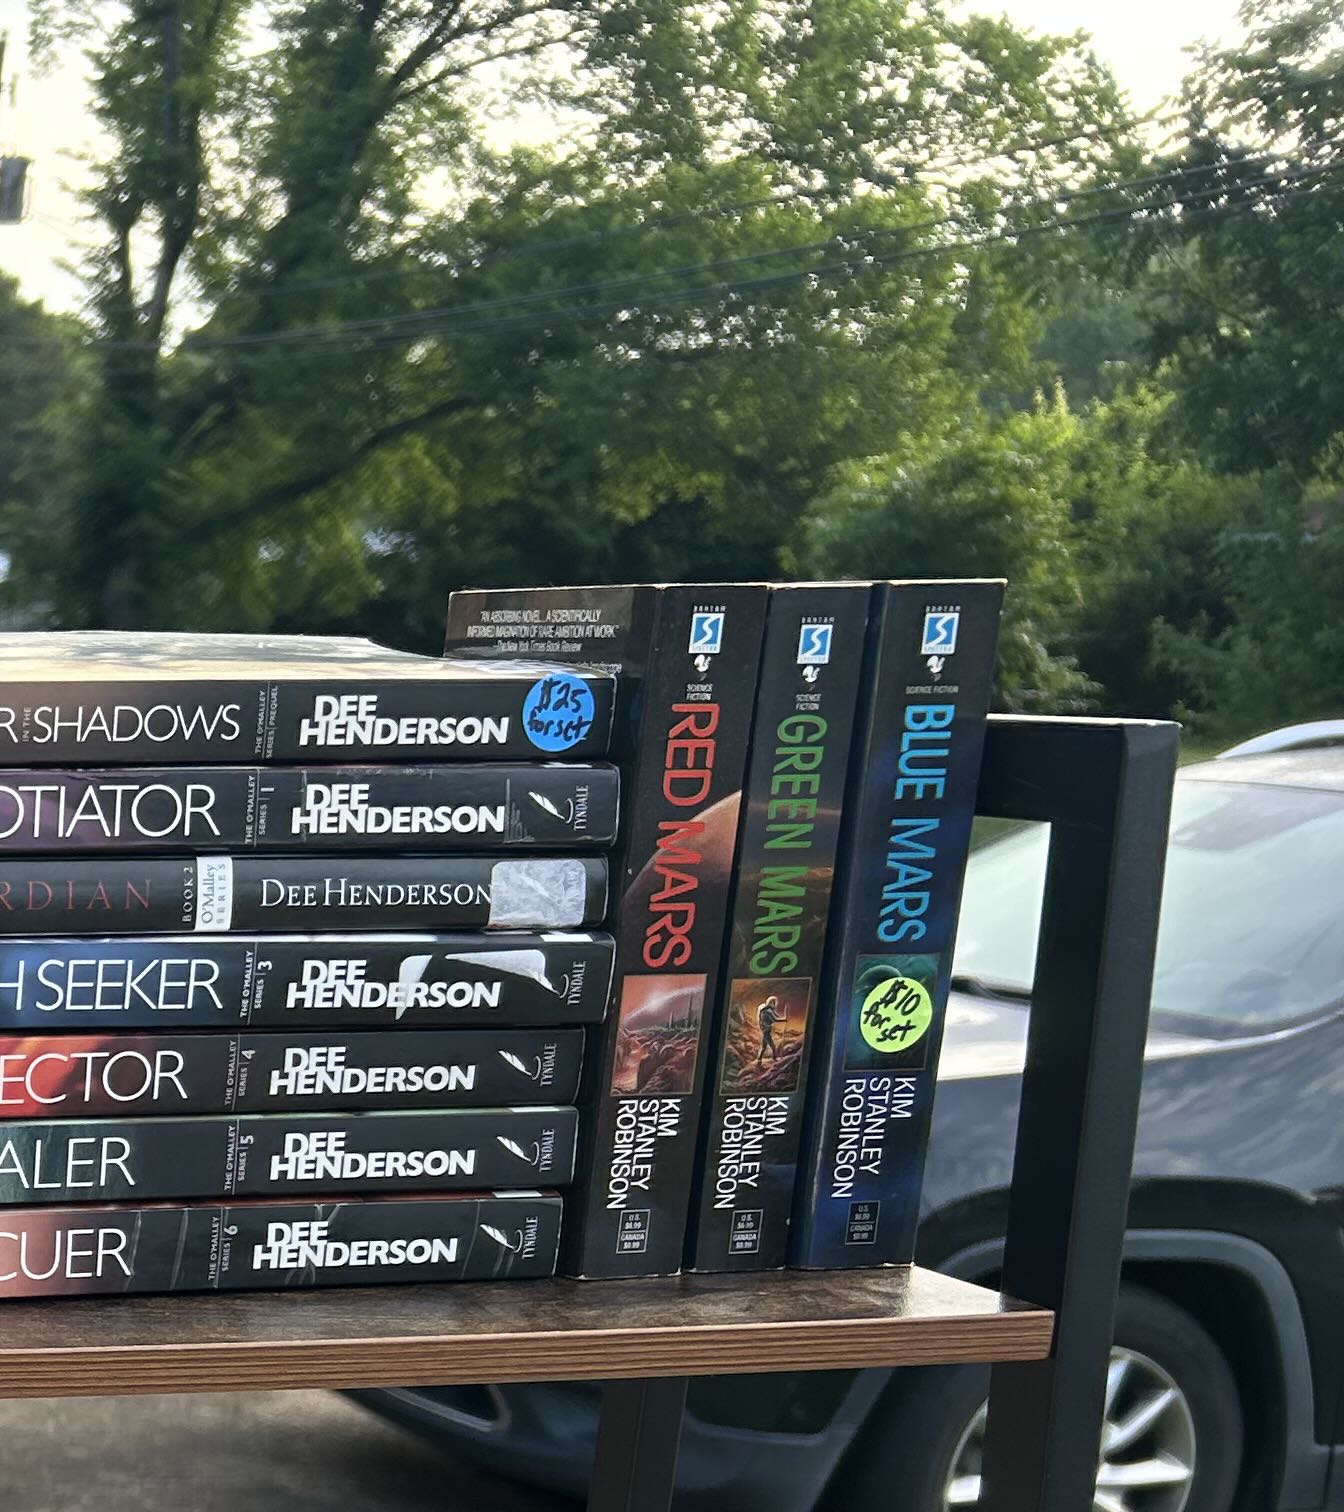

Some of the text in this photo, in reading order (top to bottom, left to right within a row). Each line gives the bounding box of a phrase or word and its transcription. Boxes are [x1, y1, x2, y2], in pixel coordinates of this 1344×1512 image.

[314, 695, 378, 722] DEE
[538, 676, 588, 714] $25
[22, 706, 32, 728] THE
[32, 704, 241, 743] SHADOWS
[299, 716, 510, 747] HENDERSON
[573, 784, 589, 832] TYNDALE
[875, 704, 955, 944] BLUE MARS
[642, 703, 720, 968] RED MARS
[749, 714, 829, 976] GREEN MARS
[35, 959, 224, 1011] SEEKER
[879, 980, 921, 1016] $10
[890, 1077, 917, 1119] KIM
[831, 1078, 867, 1199] ROBINSON
[859, 1076, 891, 1176] STANLEY
